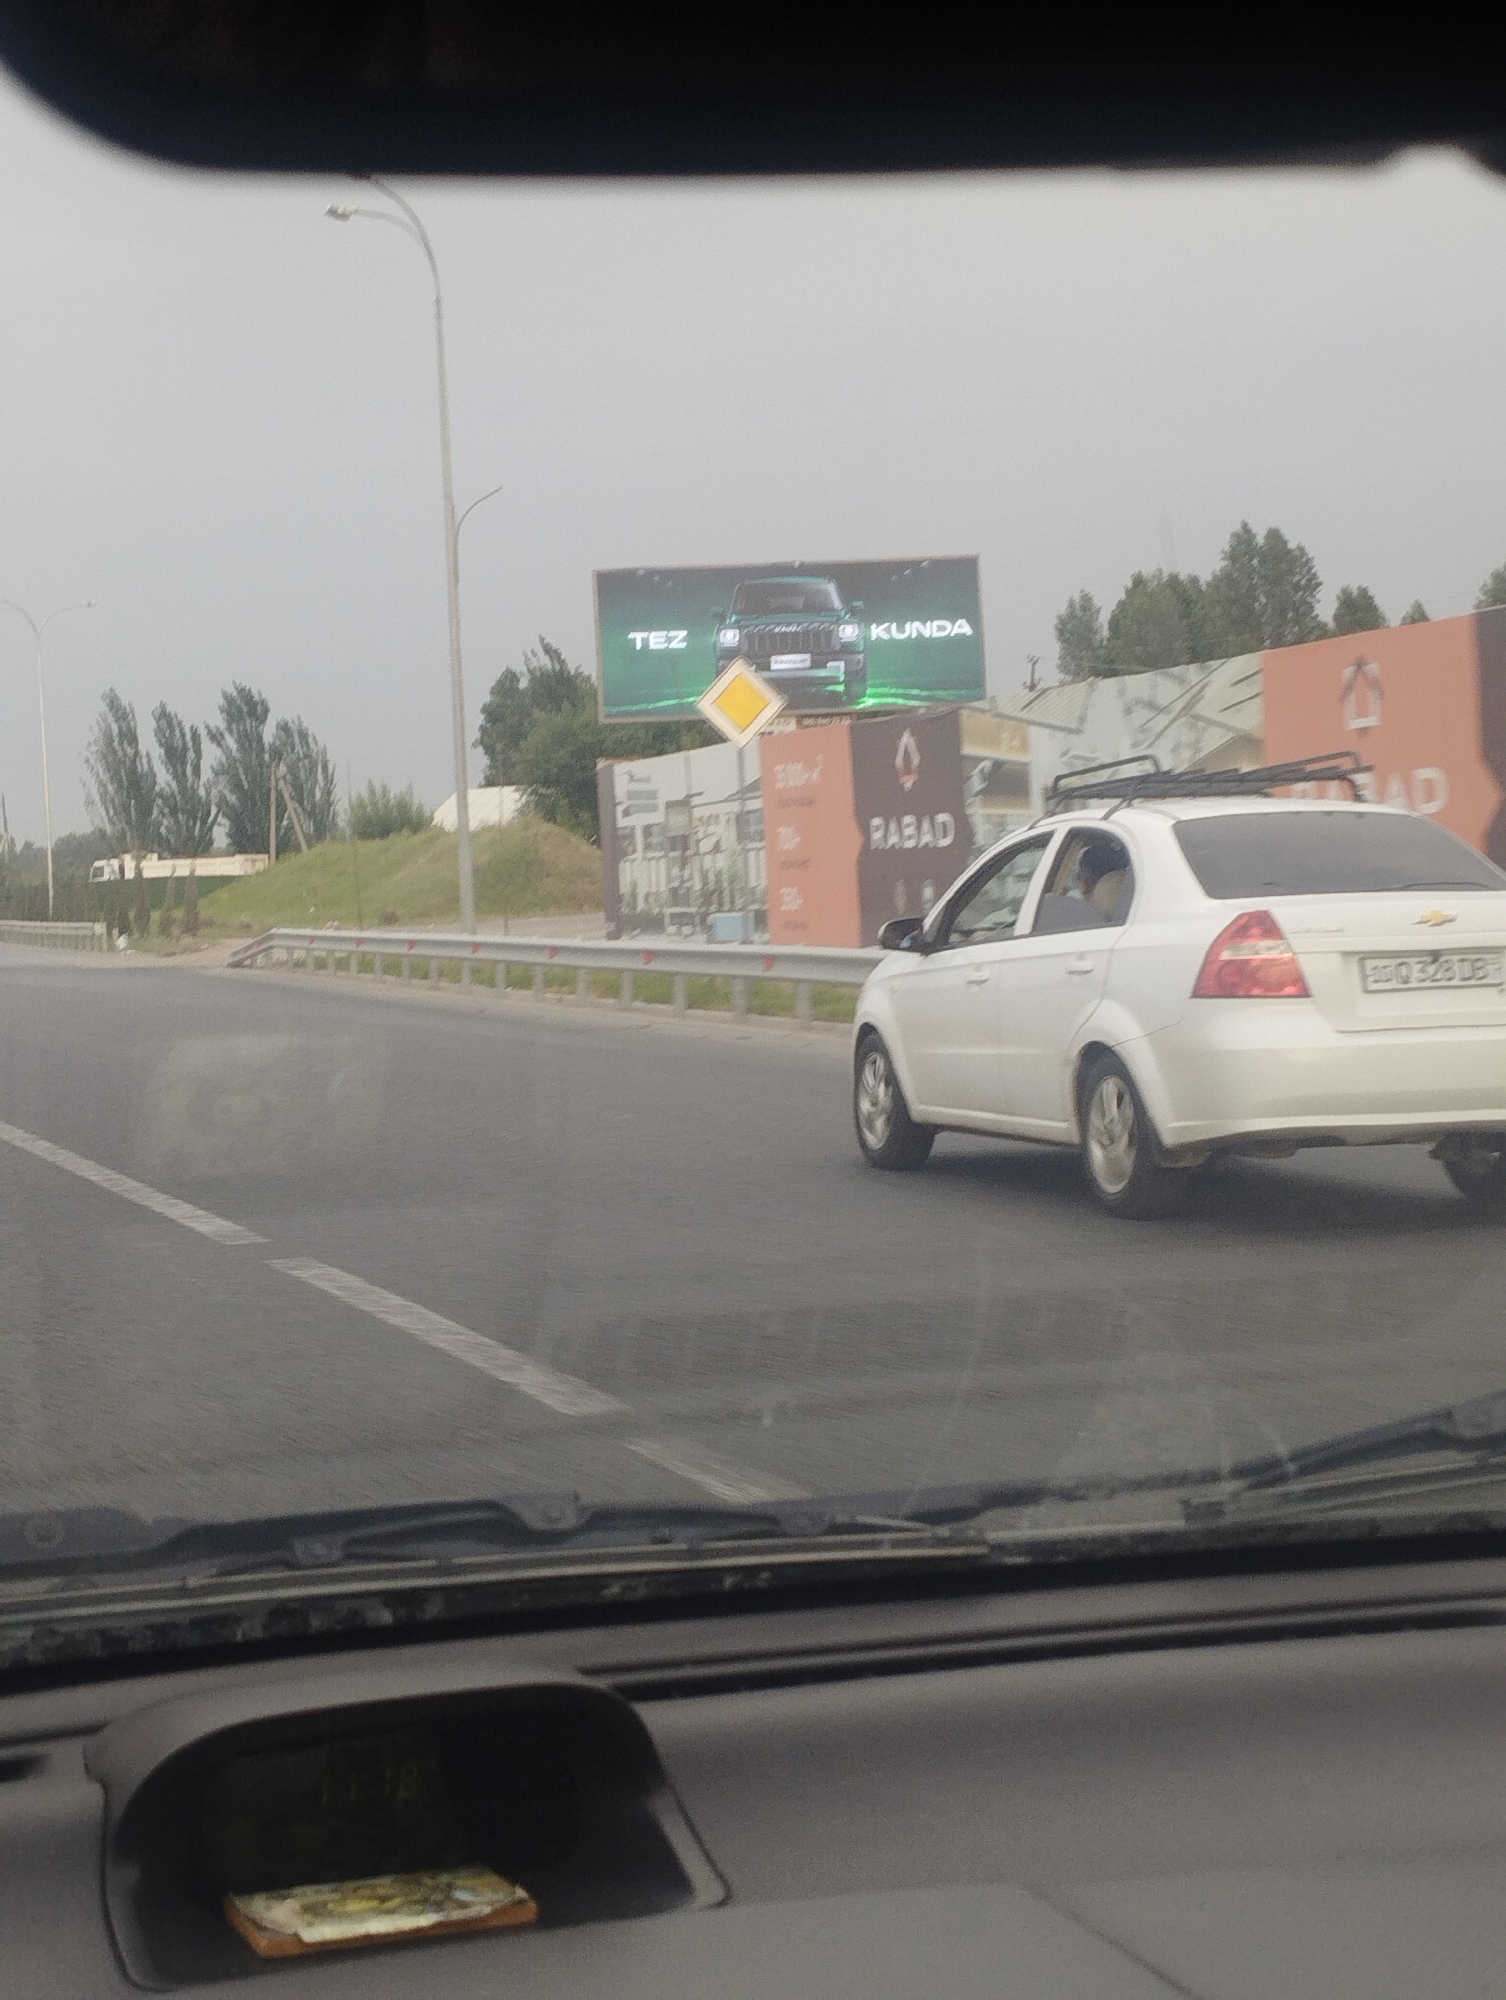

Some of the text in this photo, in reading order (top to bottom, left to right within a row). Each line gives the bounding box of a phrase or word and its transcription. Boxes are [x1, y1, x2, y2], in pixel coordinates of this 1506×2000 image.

[627, 618, 974, 651] TEZ KUNDA
[869, 811, 955, 850] RABAD
